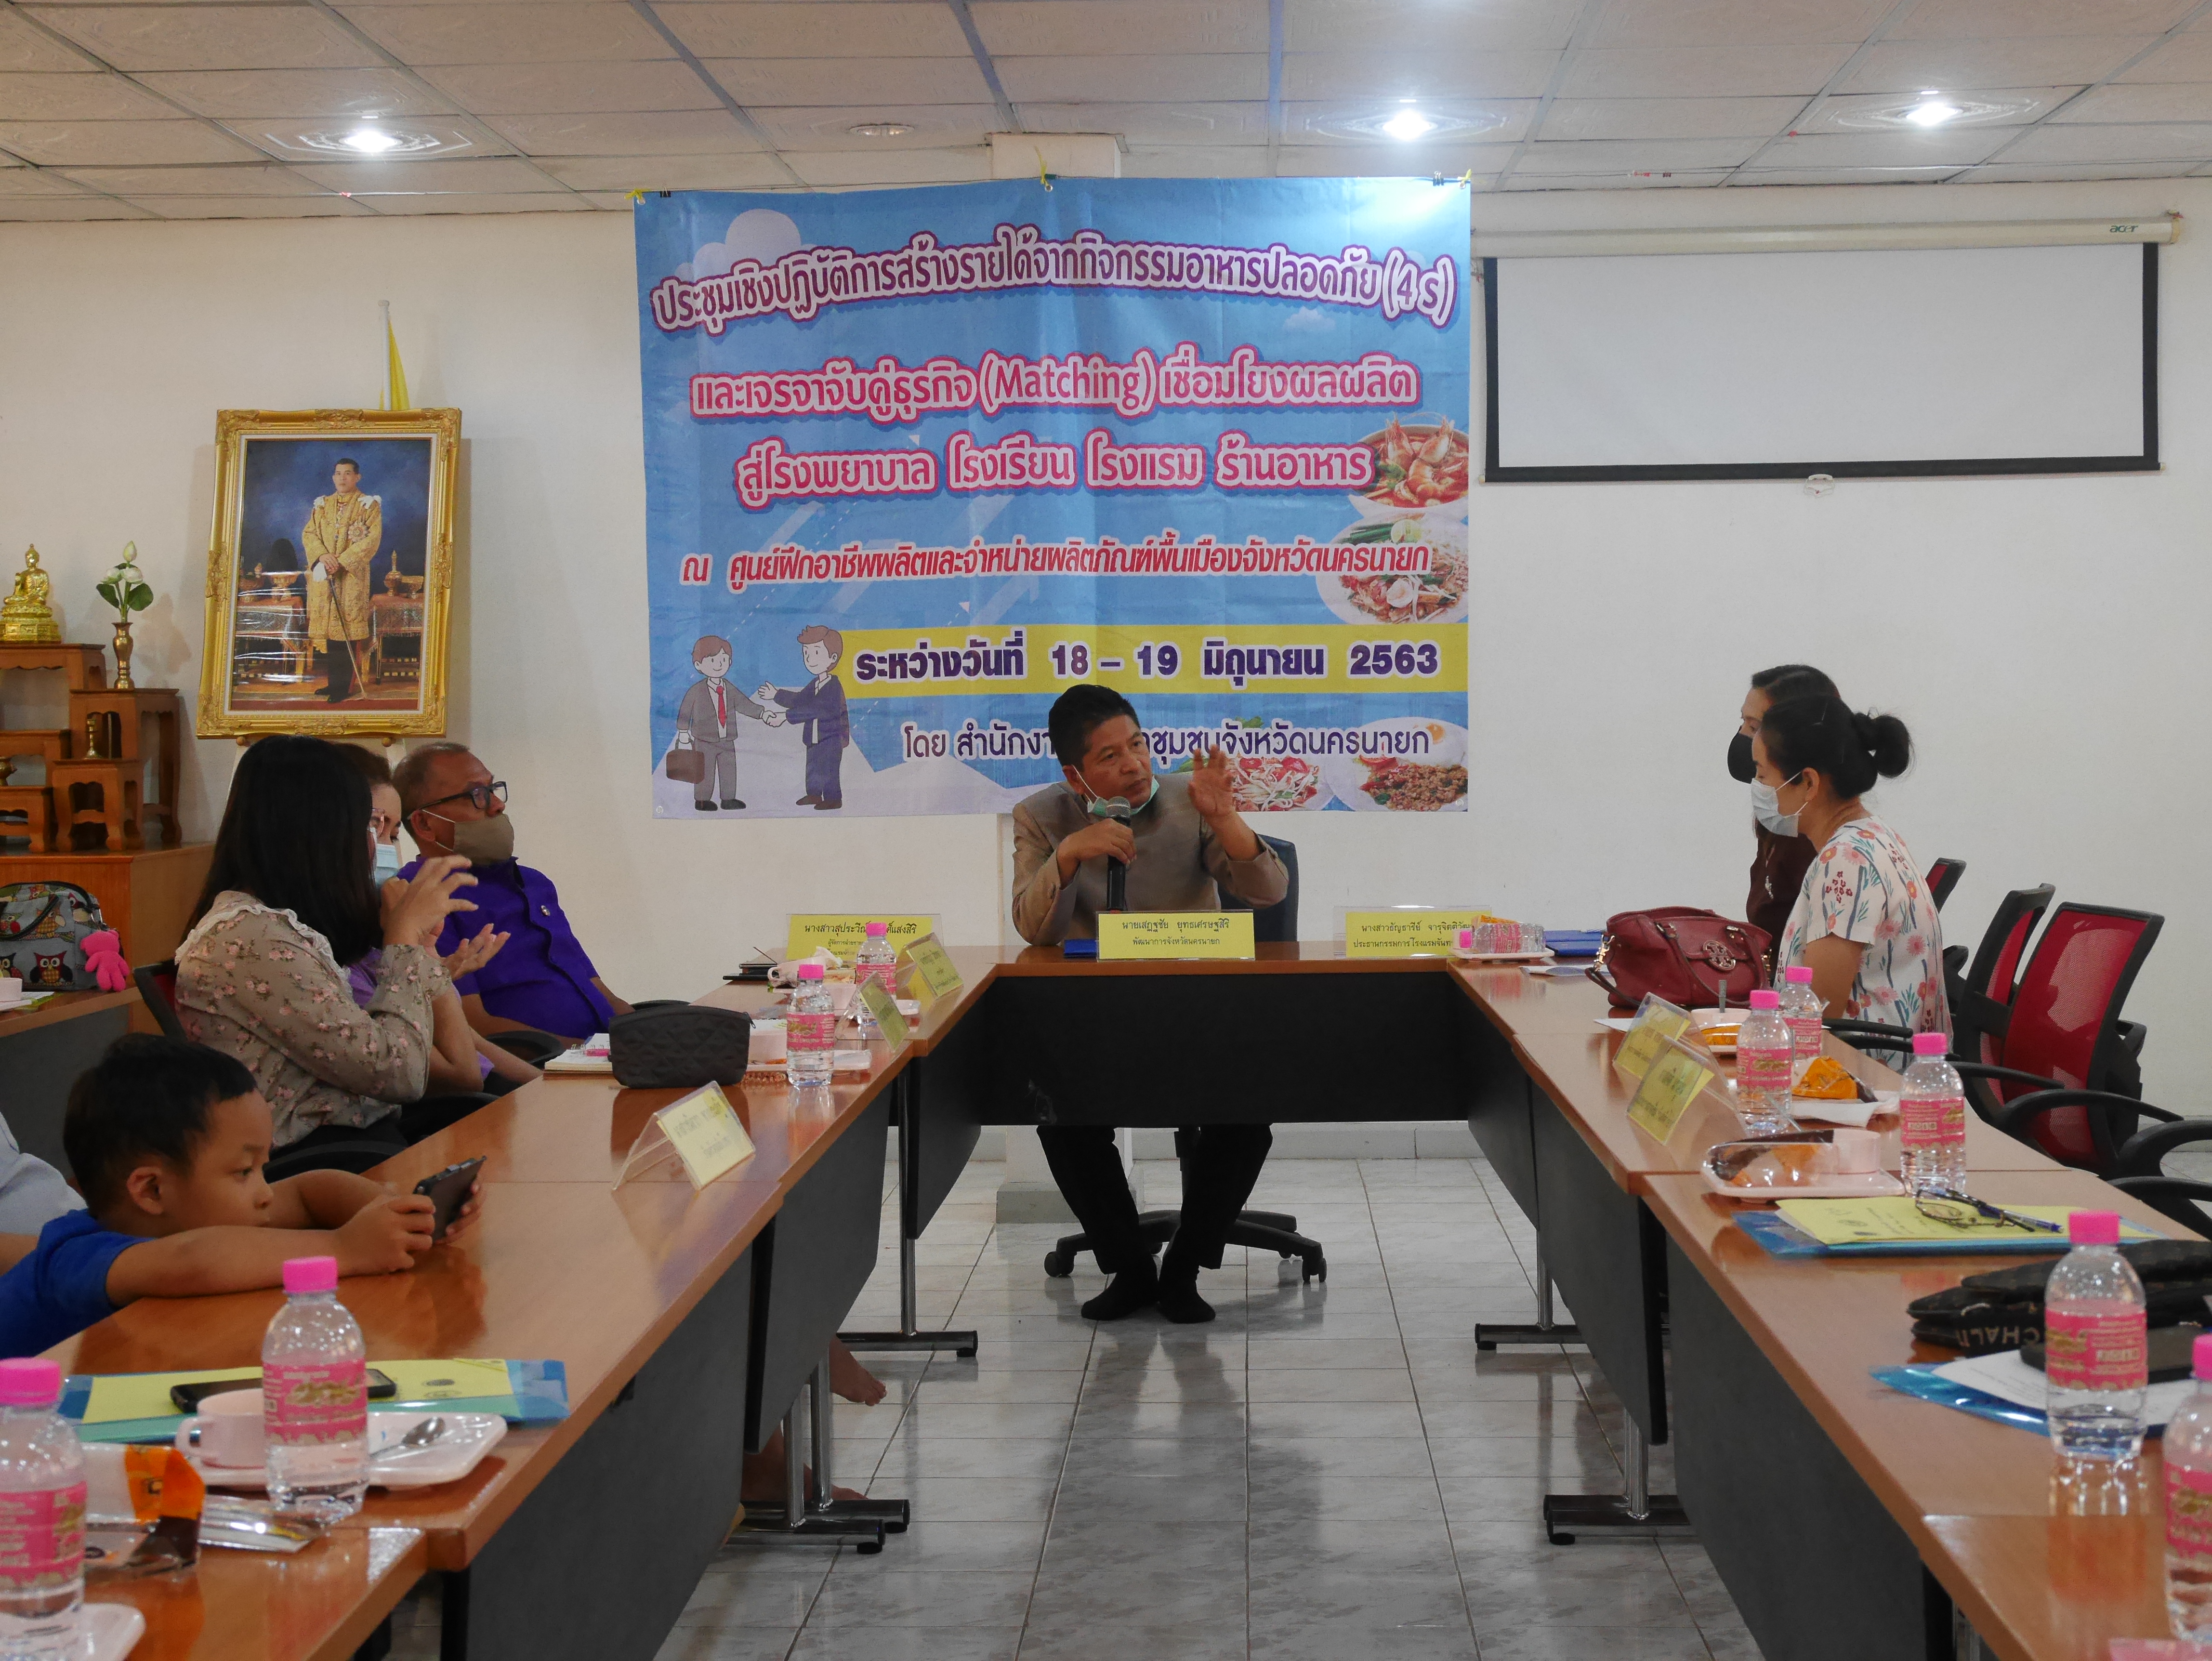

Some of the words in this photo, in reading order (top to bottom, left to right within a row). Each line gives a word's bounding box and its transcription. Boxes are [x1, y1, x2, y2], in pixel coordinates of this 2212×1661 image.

[2109, 224, 2139, 233] acer
[742, 441, 931, 499] สู่โรงพยาบาล
[952, 435, 1071, 483] โรงเรียน
[1092, 432, 1198, 482] โรงแรม
[1221, 434, 1367, 481] ร้านอาหาร
[683, 557, 709, 582] ณ
[856, 631, 1024, 681] ระหว่างวันที่
[1052, 645, 1089, 675] 18
[1137, 645, 1178, 675] 19
[1204, 640, 1324, 686] มิถุนายน
[1350, 643, 1439, 675] 2563
[904, 725, 947, 758] โดย
